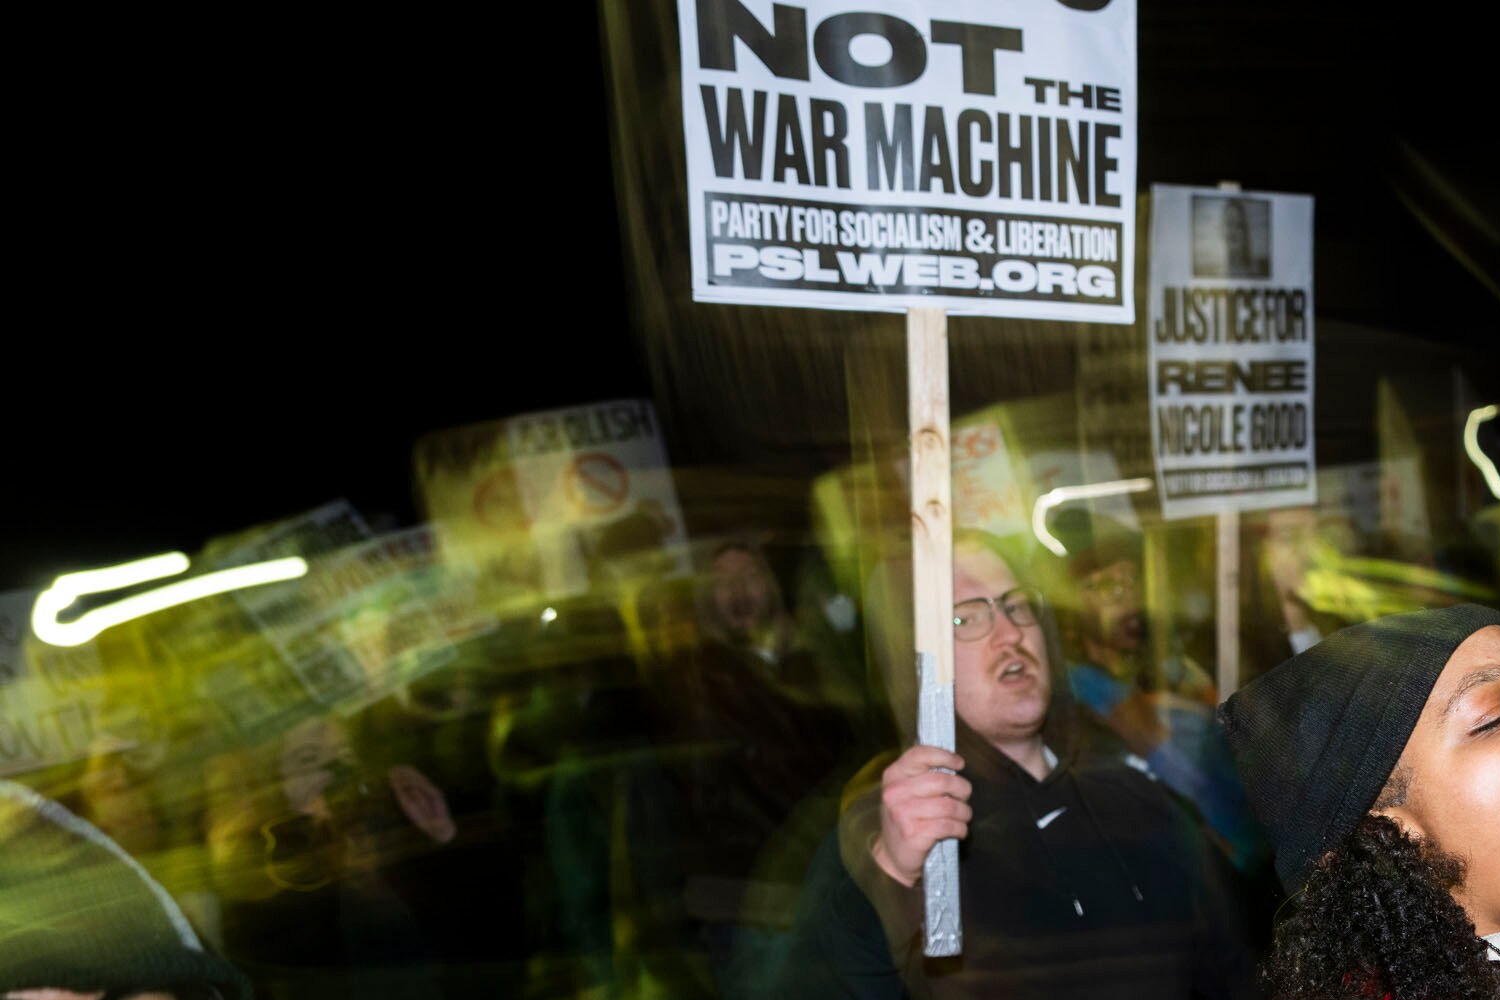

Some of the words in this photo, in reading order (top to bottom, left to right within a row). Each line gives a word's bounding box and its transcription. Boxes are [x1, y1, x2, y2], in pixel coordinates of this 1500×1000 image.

[697, 0, 1024, 97] NOT
[1024, 77, 1122, 113] THE
[699, 84, 851, 190] WAR
[864, 101, 1122, 209] MACHINE
[712, 201, 799, 242] PARTY
[796, 208, 839, 246] FOR
[840, 210, 962, 252] SOCIALISM
[965, 218, 995, 254] &
[996, 219, 1118, 263] LIBERATION
[712, 243, 1117, 298] PSLWEB.ORG
[1156, 286, 1263, 344] JUSTICE
[1157, 359, 1308, 395] RENEE
[1158, 404, 1246, 457] NICOLE
[1250, 402, 1308, 453] GOOD
